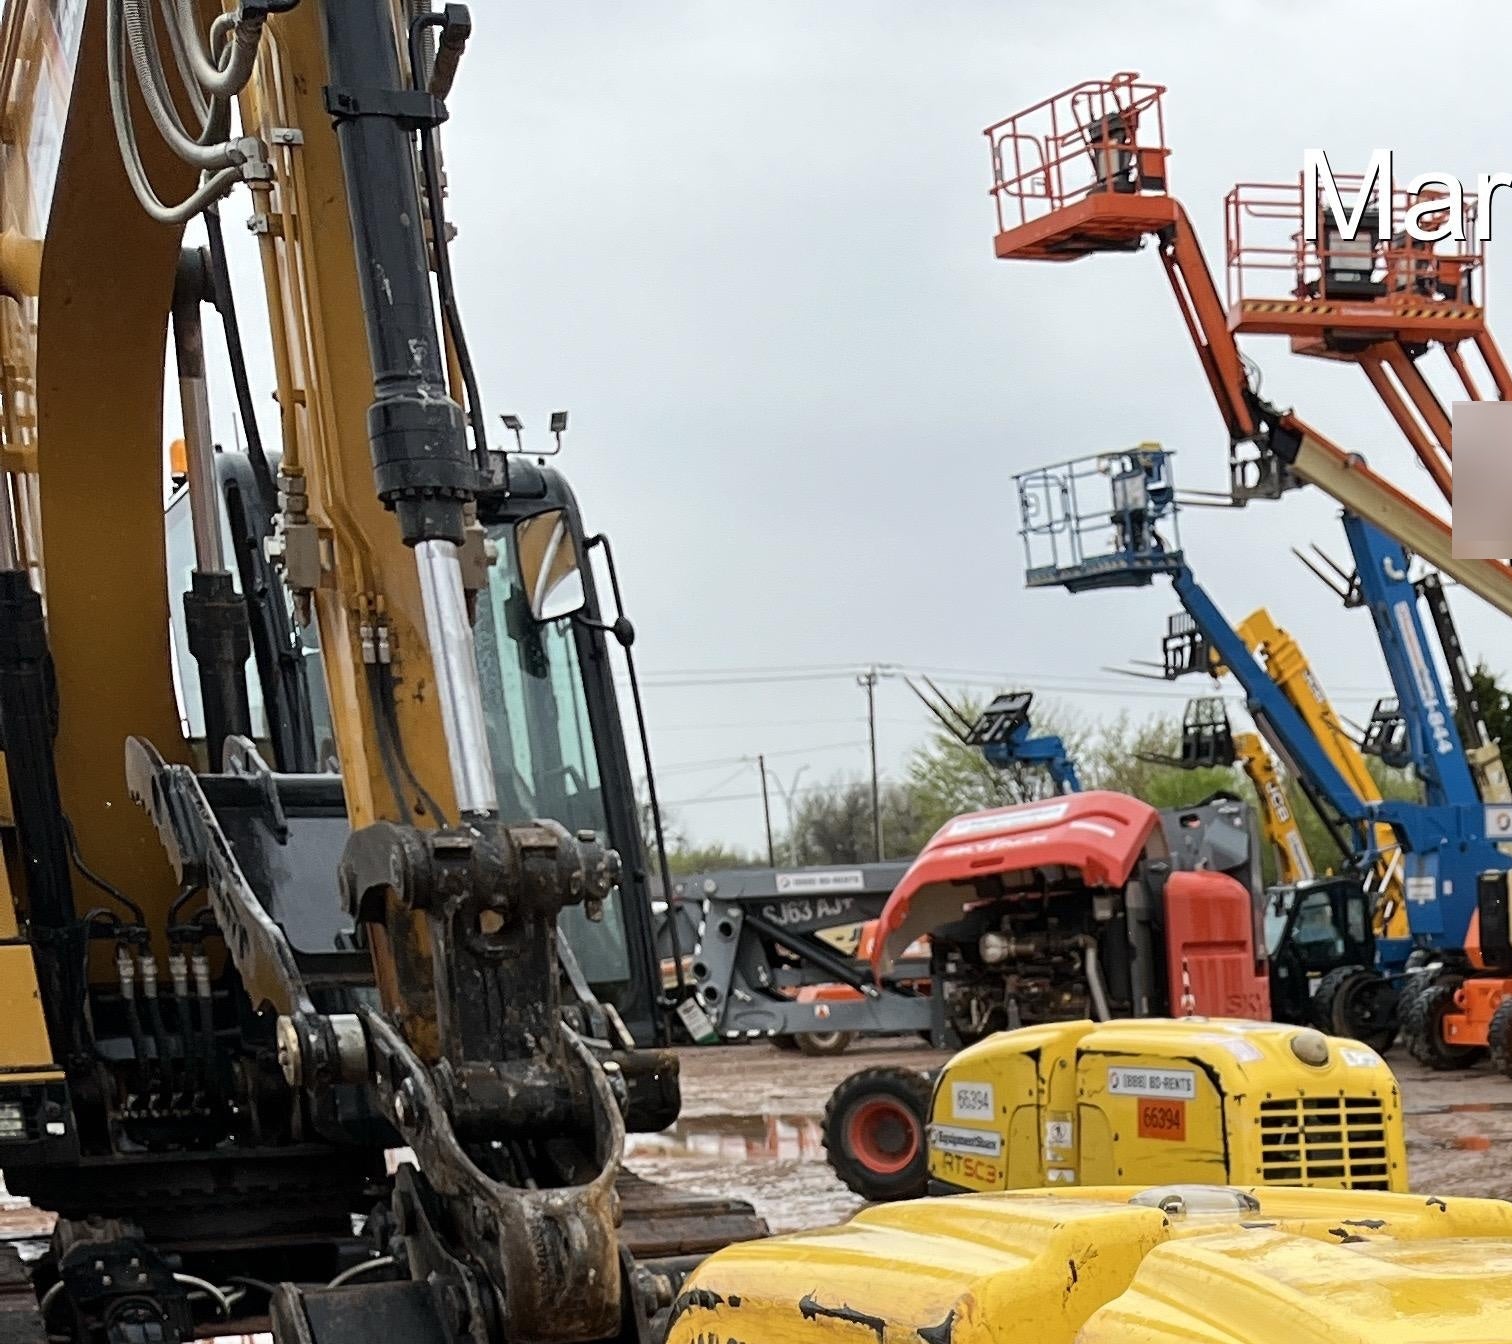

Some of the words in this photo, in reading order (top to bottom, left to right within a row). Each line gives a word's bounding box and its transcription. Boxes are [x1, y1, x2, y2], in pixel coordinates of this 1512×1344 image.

[1266, 781, 1291, 823] JCB
[763, 900, 813, 927] SJ63
[1143, 1106, 1181, 1130] 66394
[943, 1152, 998, 1184] RTSC3
